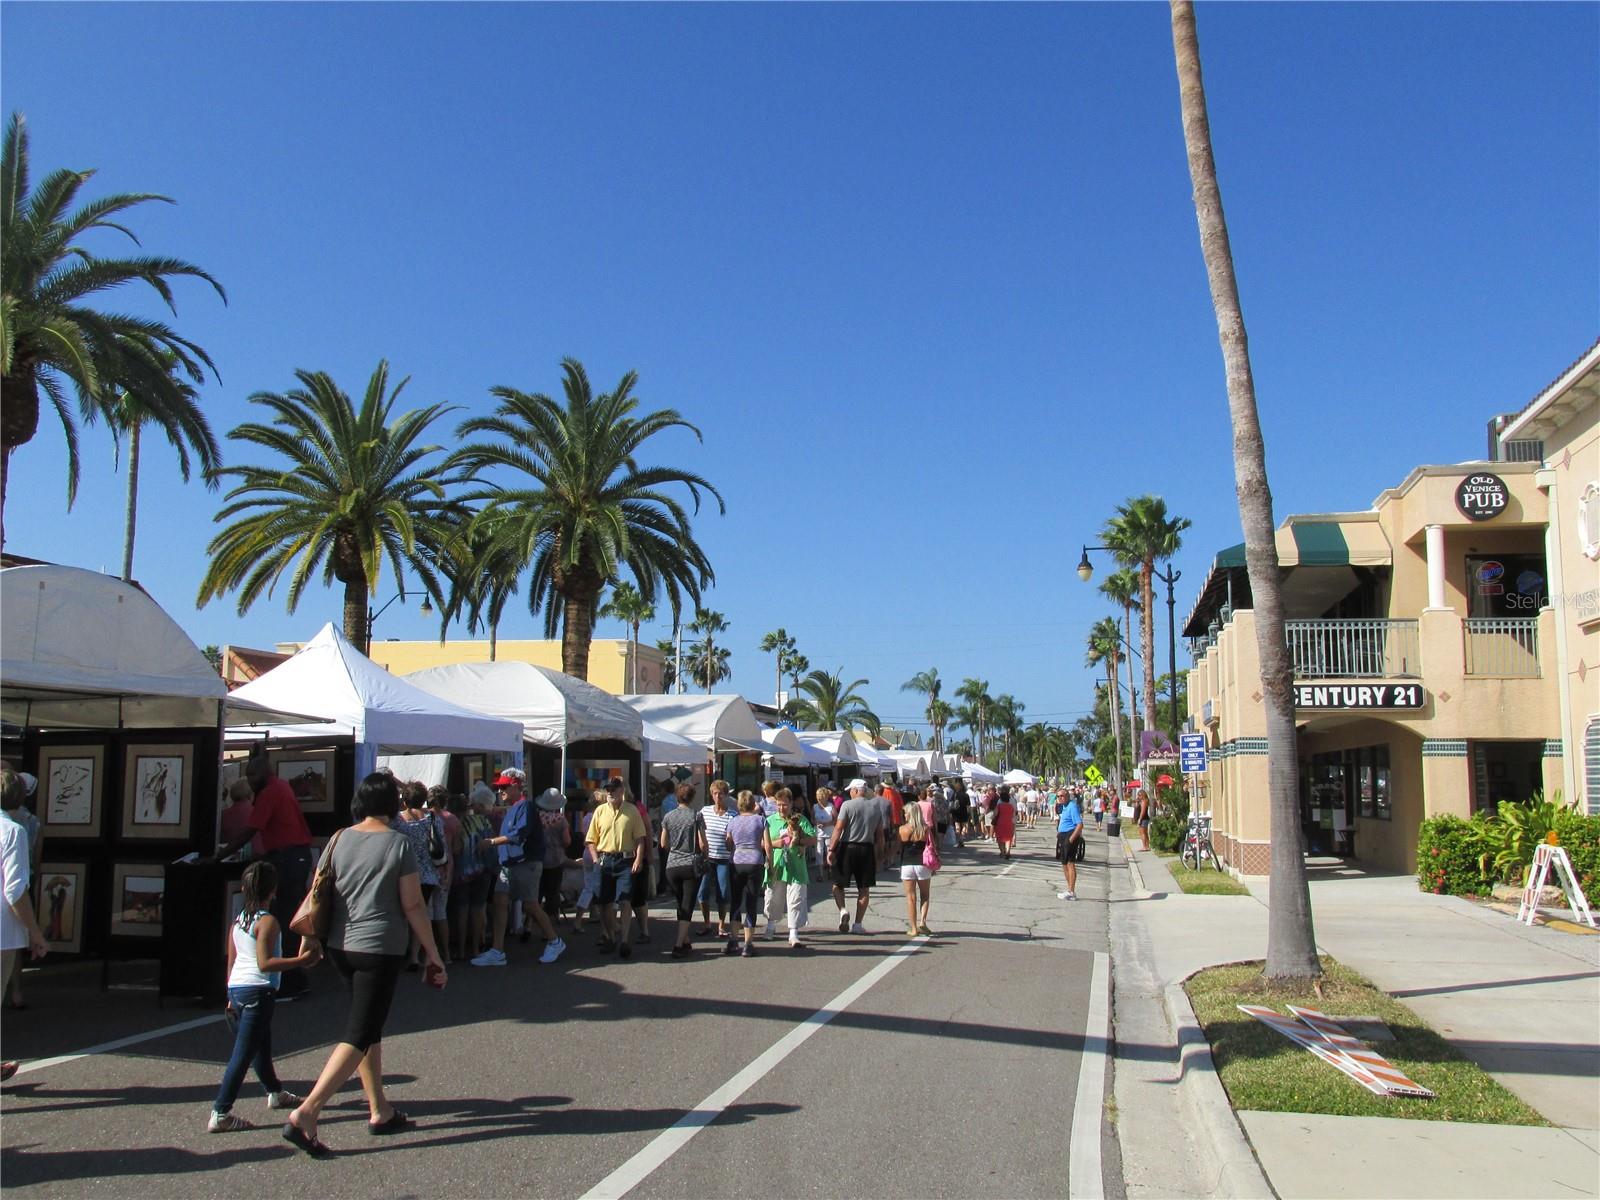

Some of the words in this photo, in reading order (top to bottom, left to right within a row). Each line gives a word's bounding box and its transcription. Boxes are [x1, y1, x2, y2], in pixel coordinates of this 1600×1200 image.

[1470, 476, 1494, 485] OLD
[1463, 493, 1505, 508] PUB
[1393, 686, 1416, 705] 21
